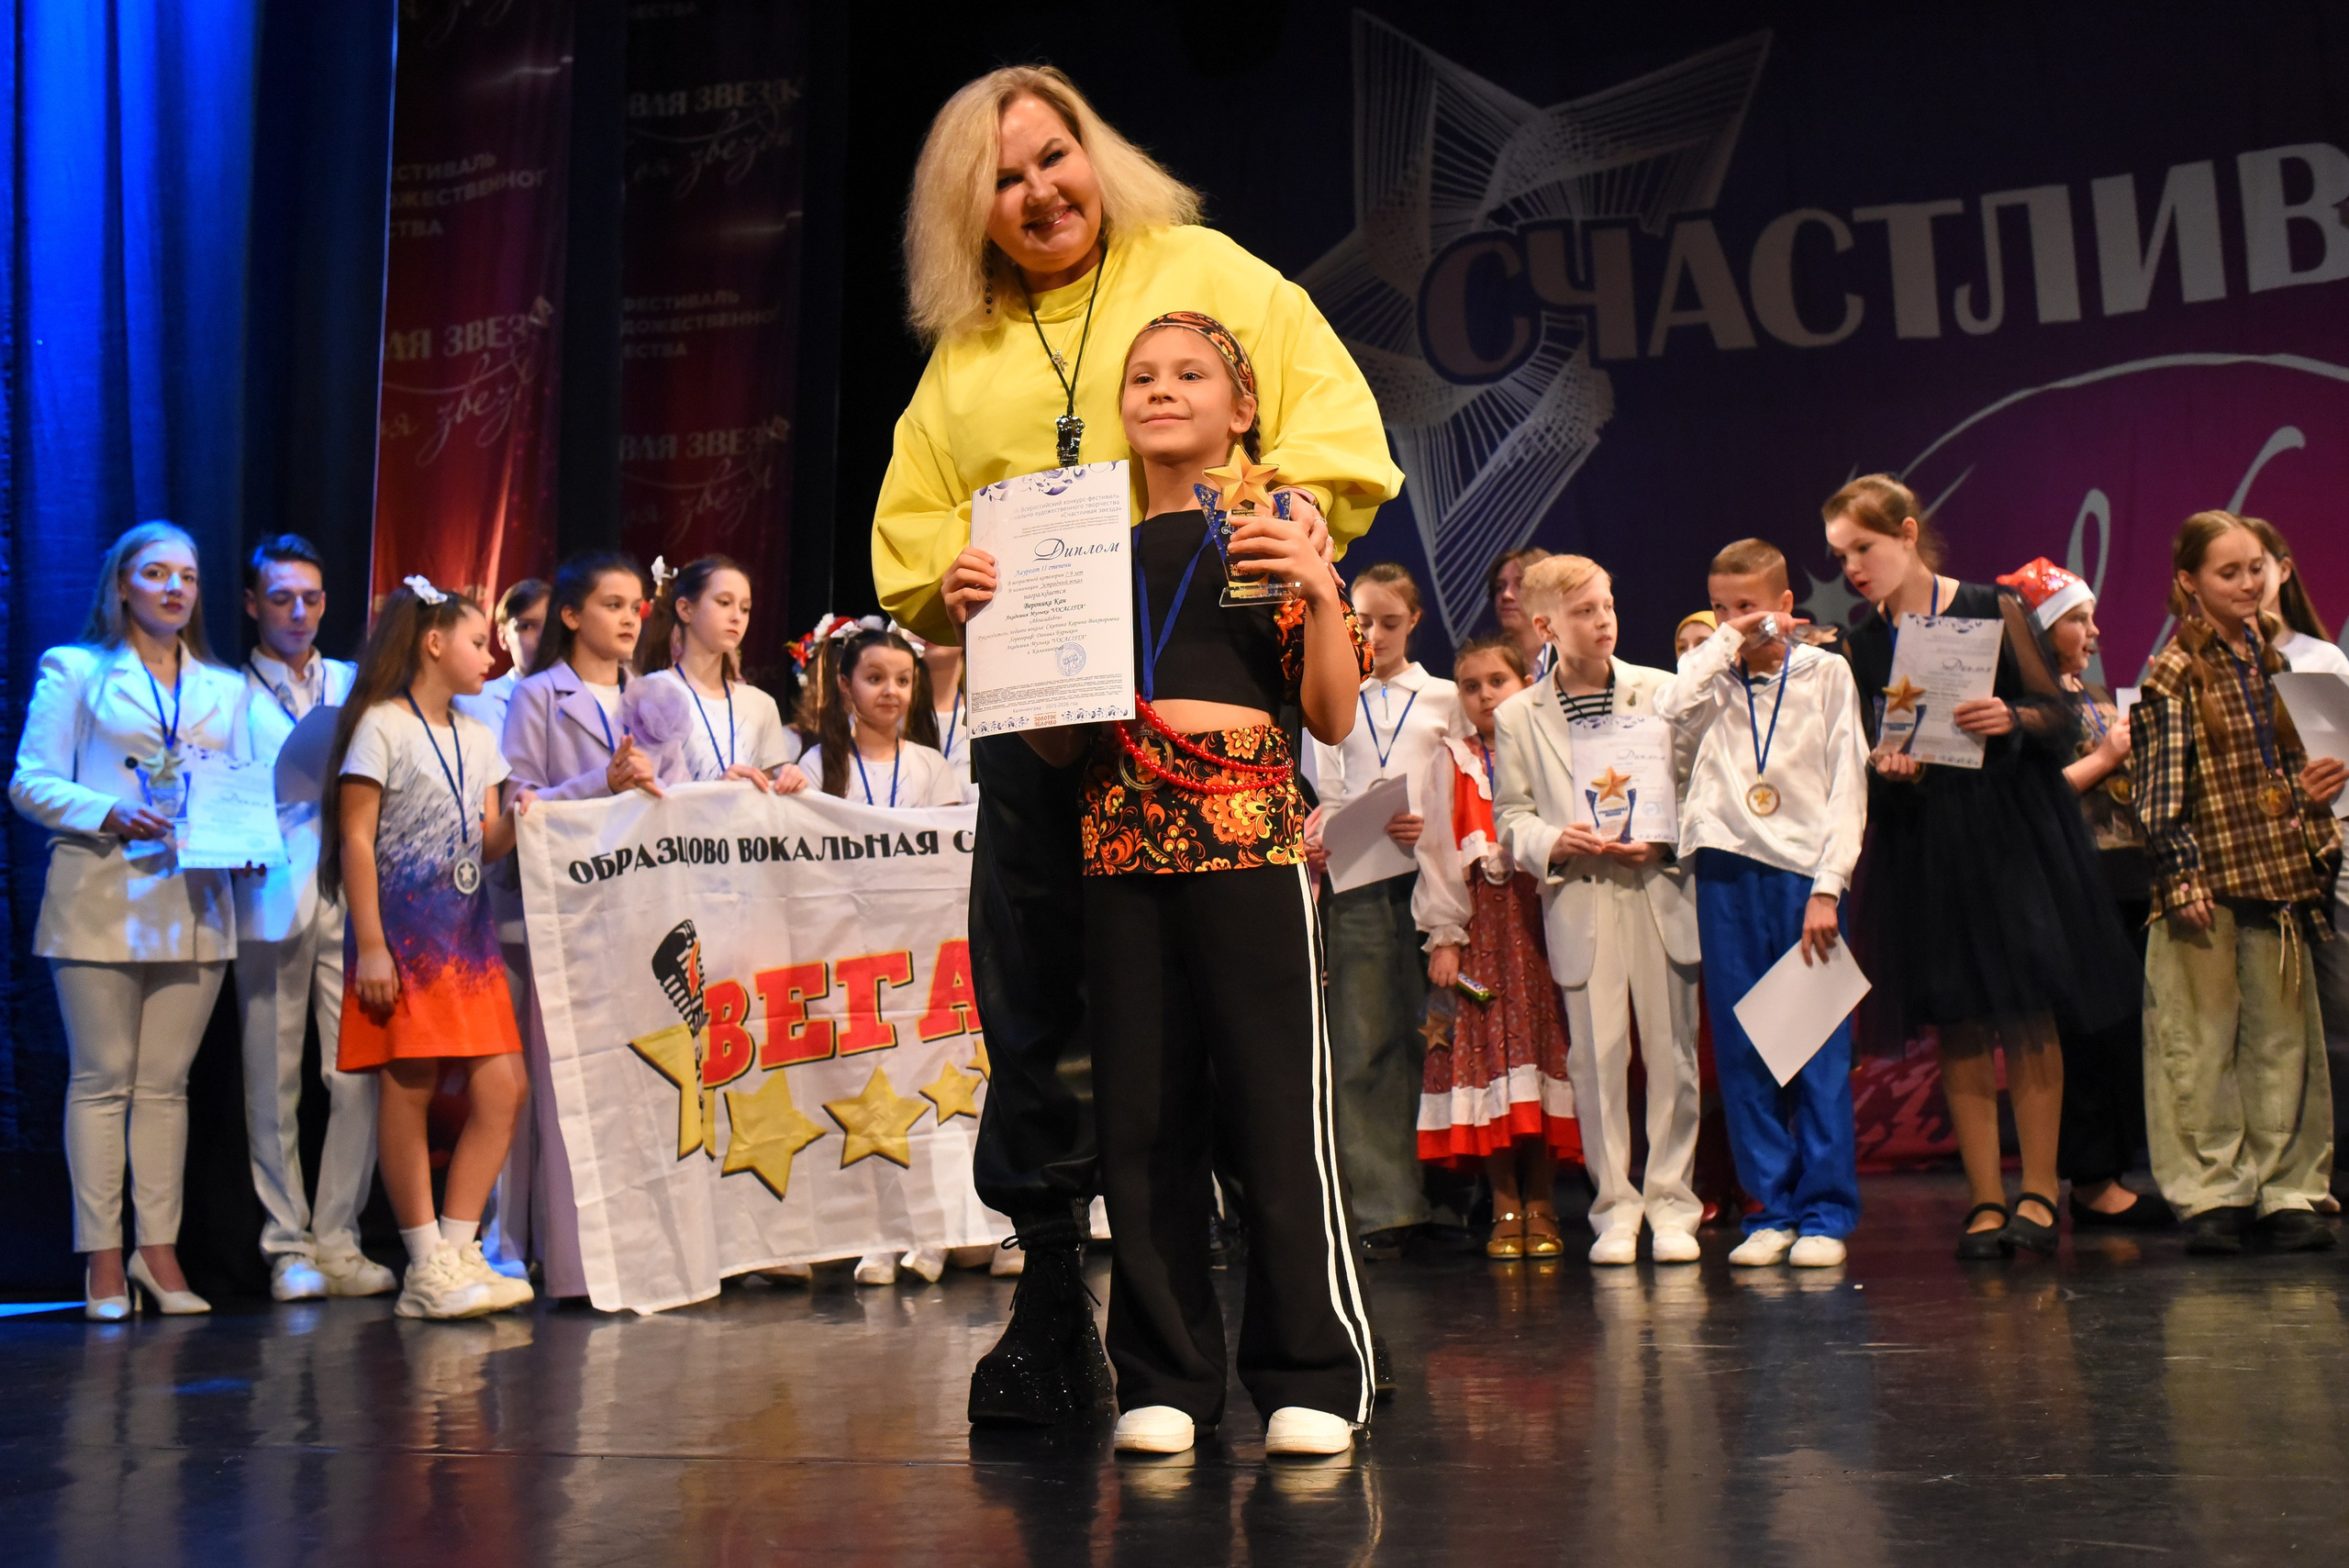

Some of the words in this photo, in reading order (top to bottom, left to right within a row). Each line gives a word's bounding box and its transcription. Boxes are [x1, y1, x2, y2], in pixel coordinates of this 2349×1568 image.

[392, 150, 497, 183] СТИВАЛЬ
[1426, 142, 2349, 377] СЧАСТЛИВ
[1032, 538, 1120, 562] Диплом
[1023, 599, 1052, 610] Вероника
[1053, 597, 1066, 606] Кан
[568, 835, 729, 884] ОБРАЗЦОВО
[738, 829, 940, 863] ВОКАЛЬНАЯ
